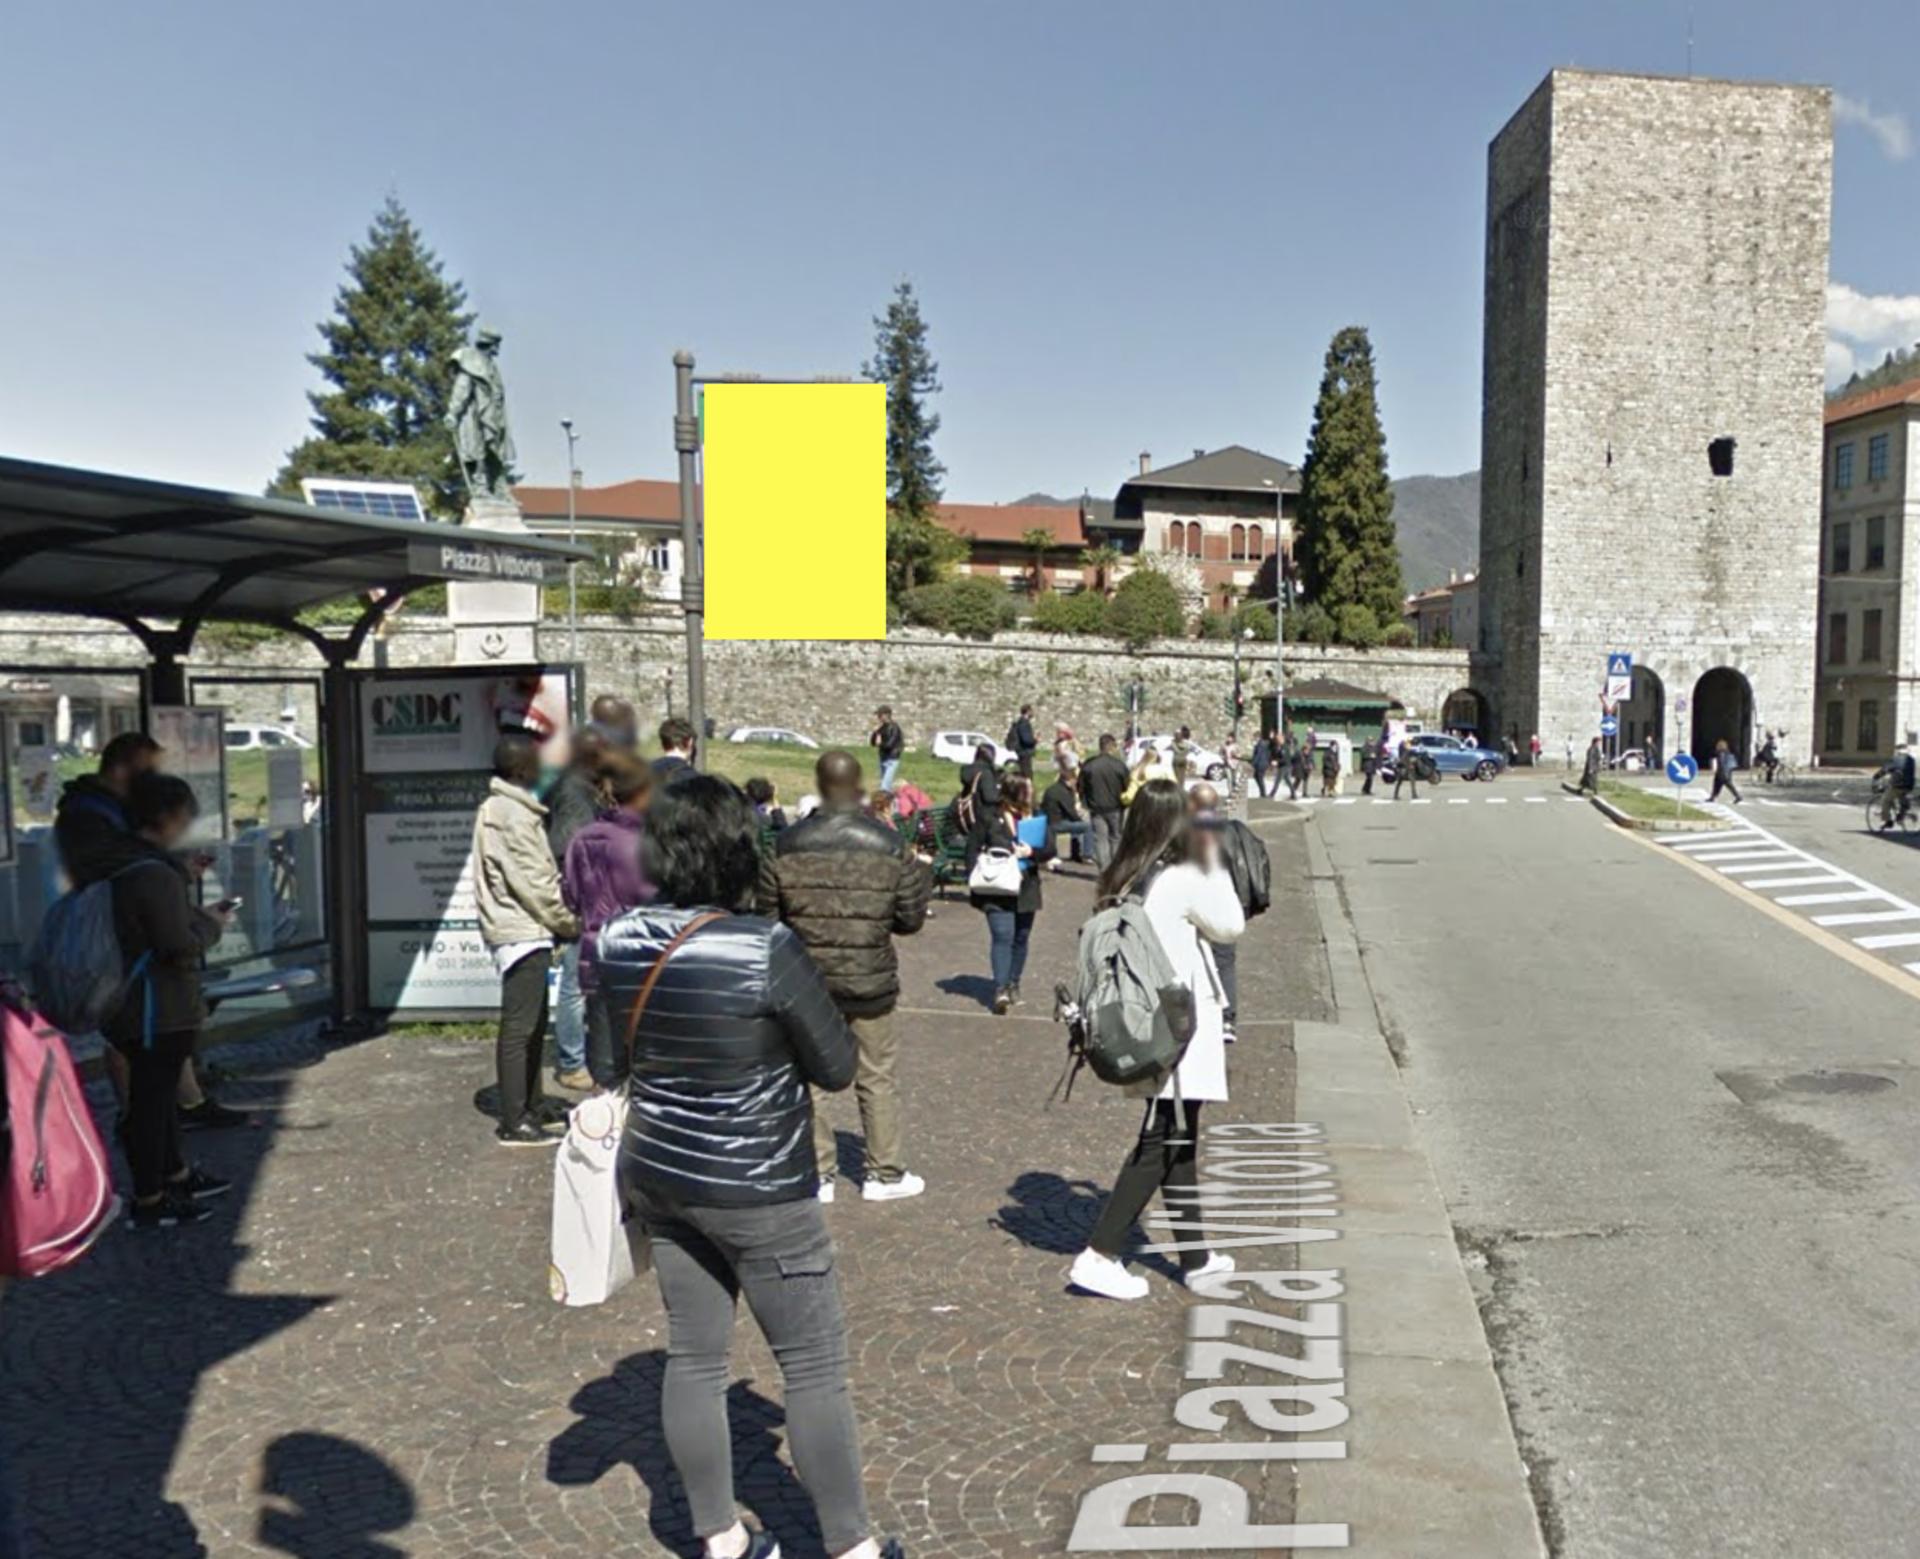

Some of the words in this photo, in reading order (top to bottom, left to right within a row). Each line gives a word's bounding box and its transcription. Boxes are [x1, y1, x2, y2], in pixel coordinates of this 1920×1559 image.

[440, 546, 491, 572] Piazza
[371, 691, 462, 730] CSDC
[459, 940, 481, 953] Via
